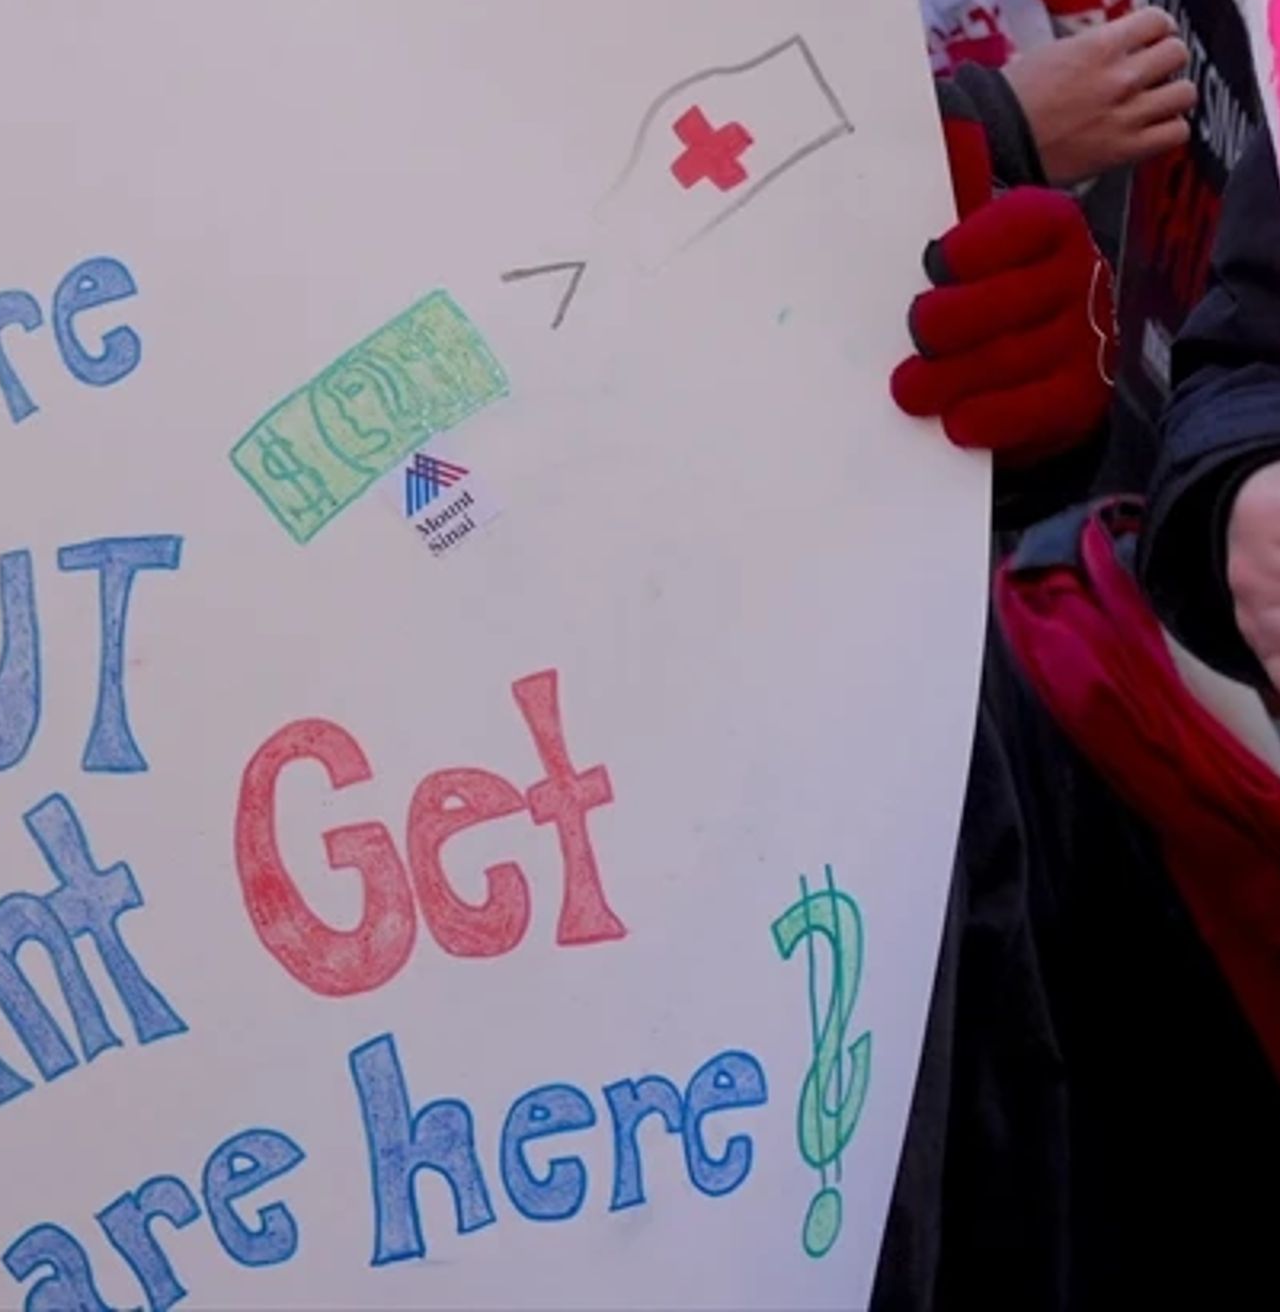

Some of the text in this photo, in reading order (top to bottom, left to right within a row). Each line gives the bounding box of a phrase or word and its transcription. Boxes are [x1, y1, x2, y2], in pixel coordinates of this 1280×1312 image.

[416, 490, 475, 540] Mount
[428, 513, 477, 558] Sinai
[233, 666, 629, 998] Get
